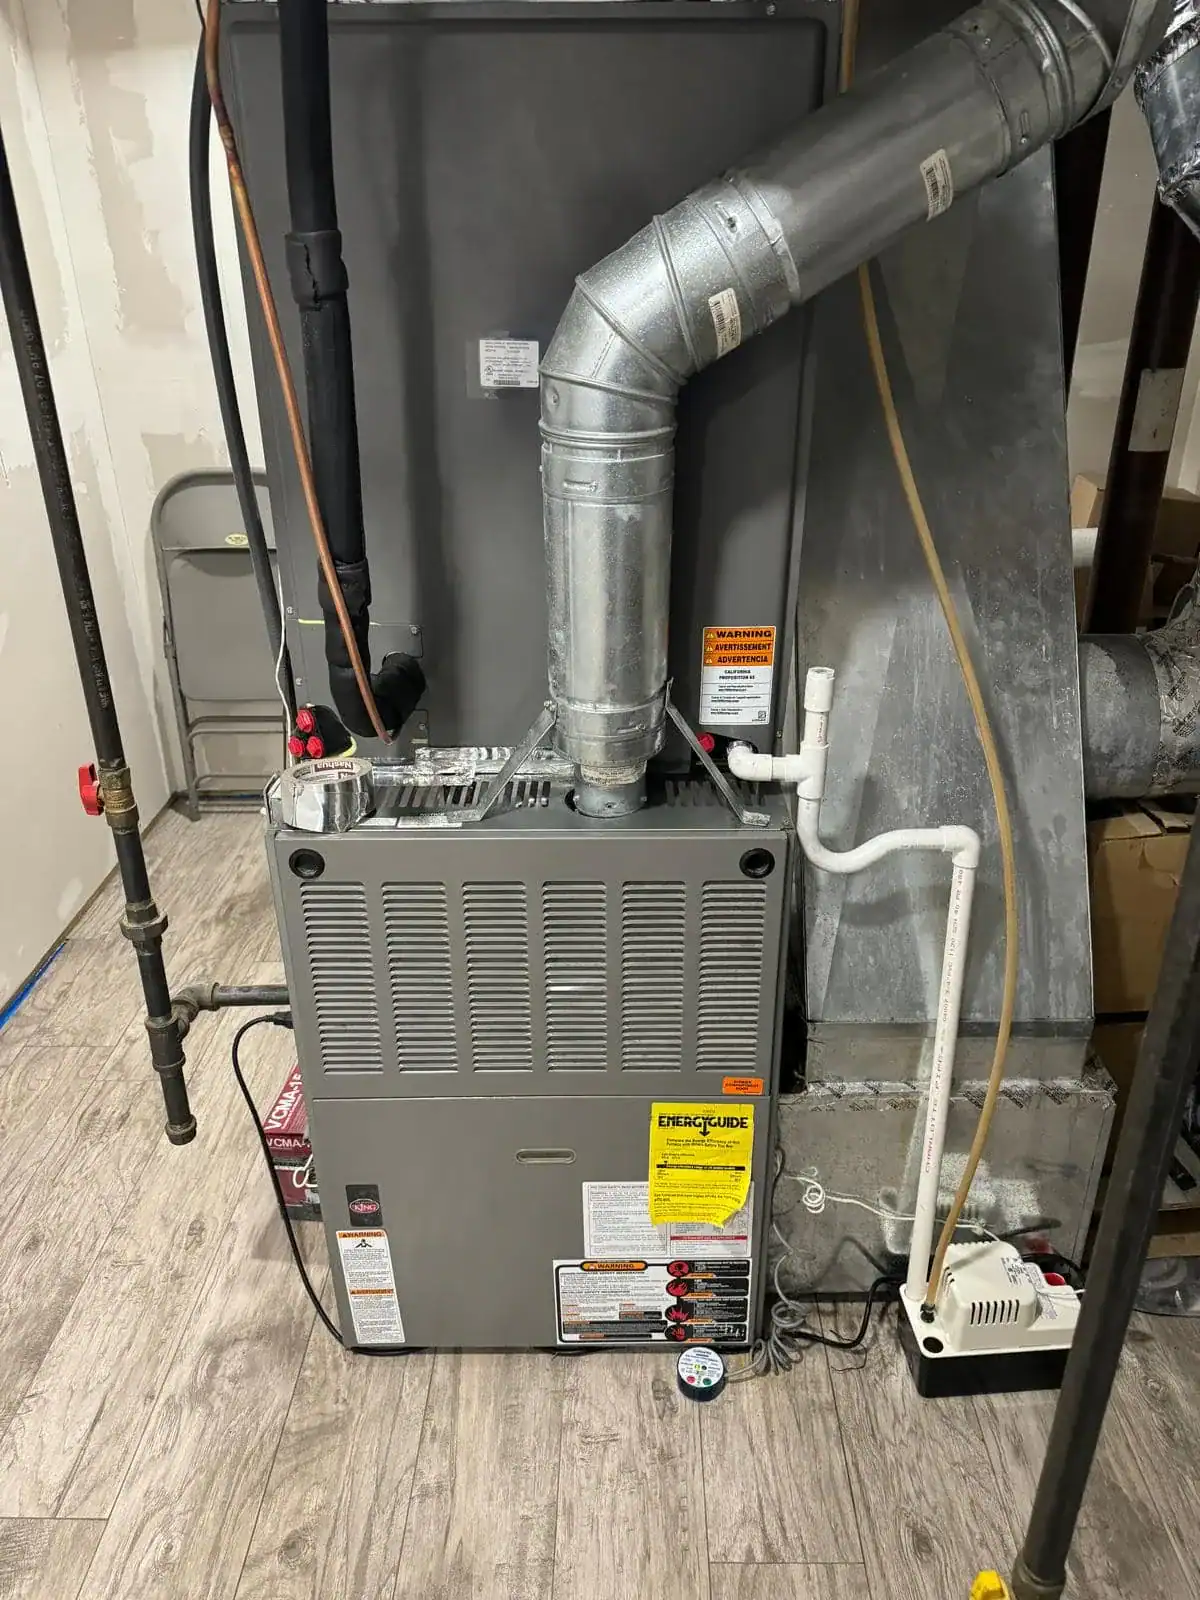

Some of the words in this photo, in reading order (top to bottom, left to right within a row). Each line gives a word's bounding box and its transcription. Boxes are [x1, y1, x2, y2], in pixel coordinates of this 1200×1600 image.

[716, 630, 772, 638] WARNING
[715, 643, 771, 651] AVERTISSEMENT
[717, 655, 768, 663] ADVERTENCIA
[316, 761, 352, 769] Nashua
